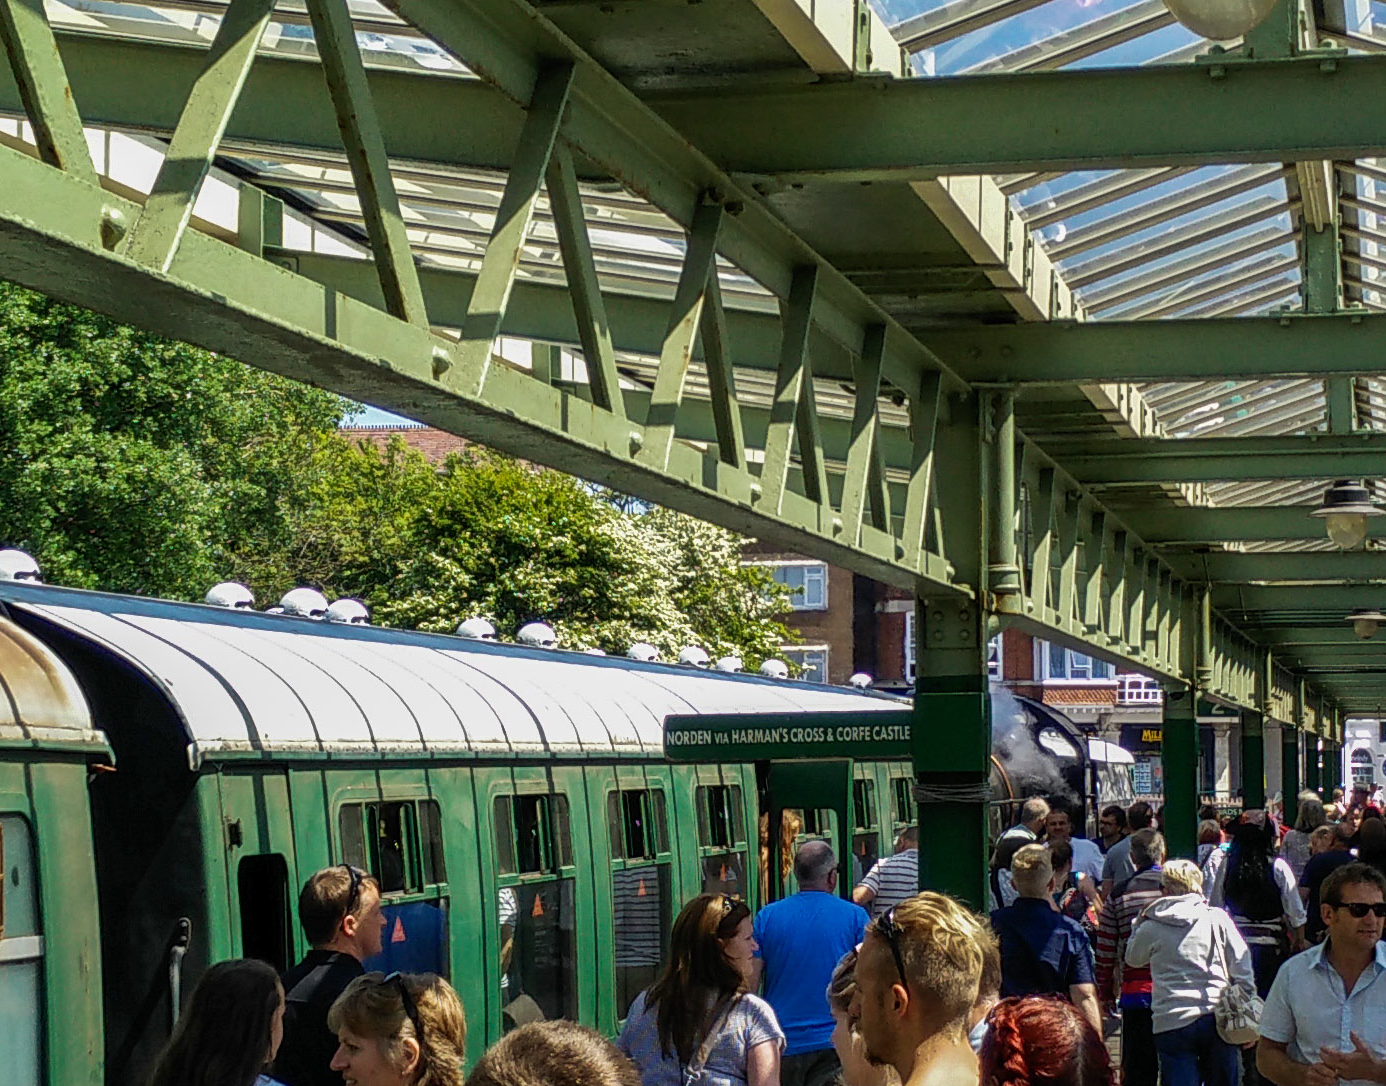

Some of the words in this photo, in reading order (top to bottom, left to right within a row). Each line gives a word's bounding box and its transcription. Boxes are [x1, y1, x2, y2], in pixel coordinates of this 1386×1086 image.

[666, 729, 712, 746] NORDEN
[714, 732, 729, 745] VIA
[731, 728, 789, 744] HARMAN'S
[790, 727, 824, 743] CROSS
[826, 728, 834, 742] &
[836, 726, 871, 742] CORFE
[872, 725, 911, 741] CASTLE
